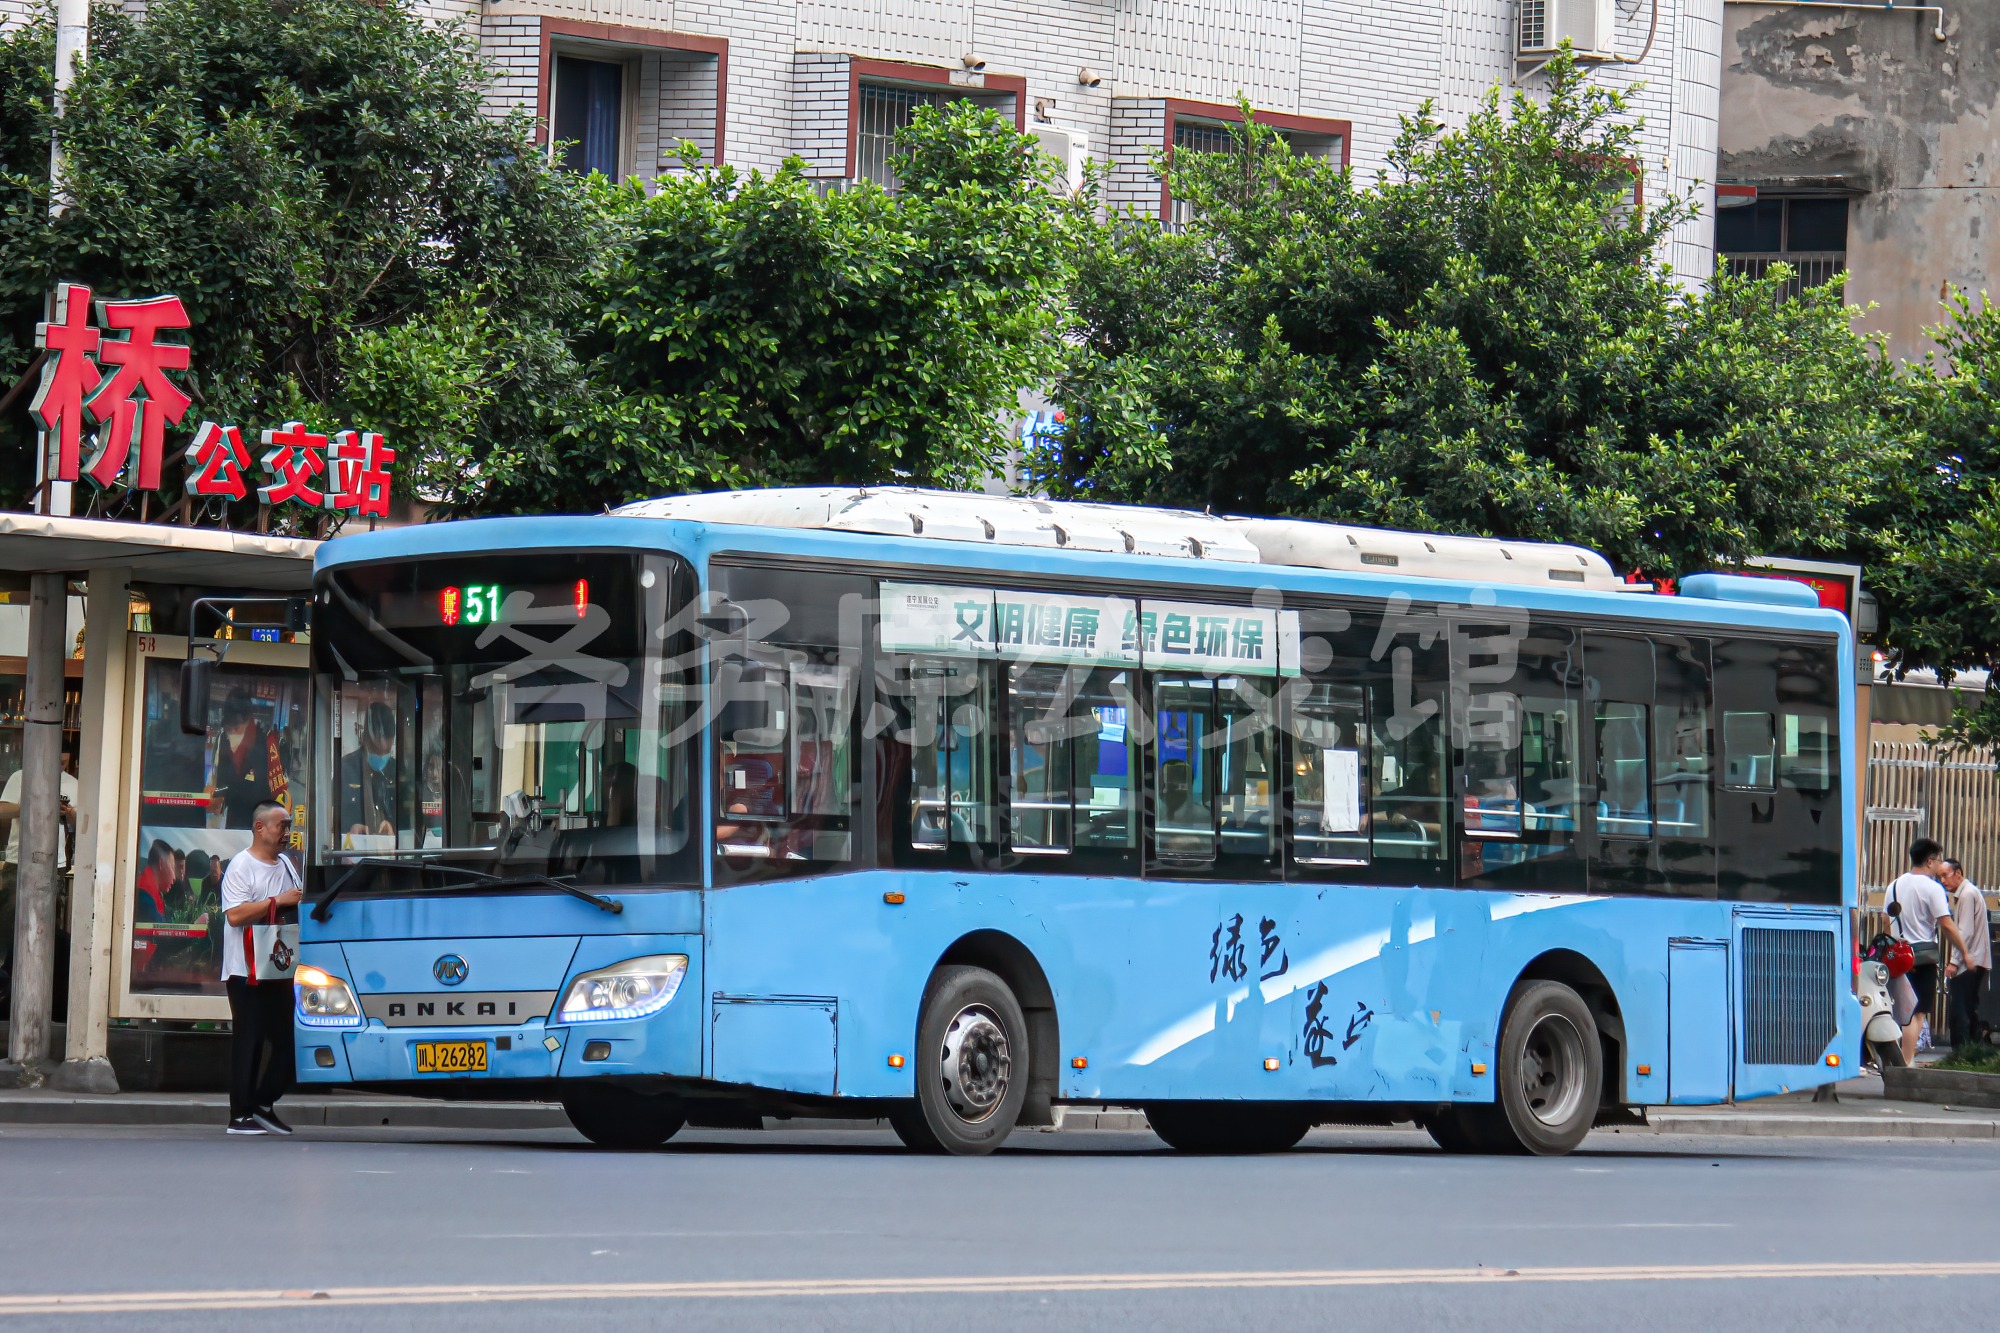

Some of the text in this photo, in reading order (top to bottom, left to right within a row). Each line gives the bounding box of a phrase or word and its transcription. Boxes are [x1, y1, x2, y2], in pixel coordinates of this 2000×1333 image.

[28, 283, 396, 518] 桥 公交站
[466, 585, 499, 623] 51
[138, 636, 156, 652] 58
[951, 599, 1264, 660] 文明健康 绿色环保
[1210, 912, 1289, 984] 绿色
[388, 1001, 517, 1017] ANKAI
